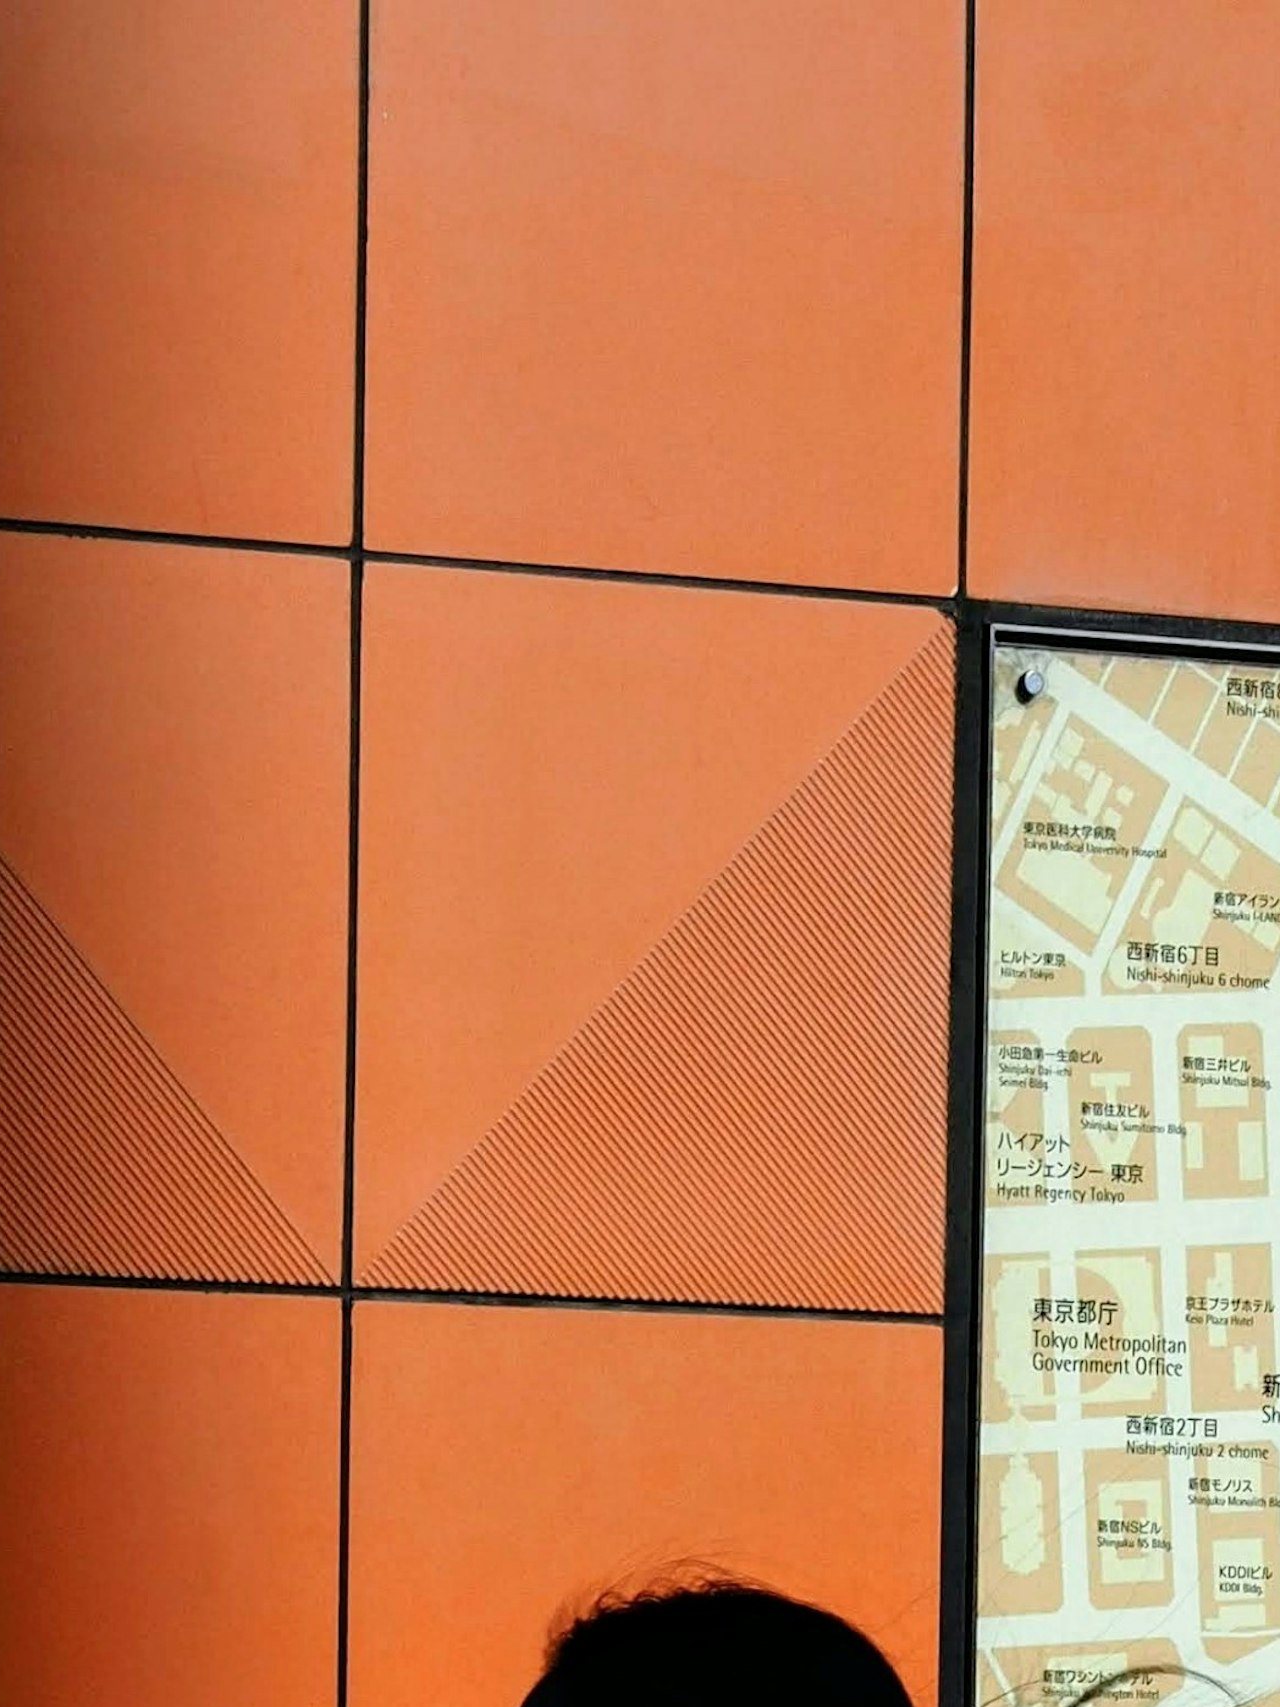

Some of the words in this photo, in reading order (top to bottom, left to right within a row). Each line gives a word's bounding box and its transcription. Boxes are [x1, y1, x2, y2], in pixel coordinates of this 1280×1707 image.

[1001, 951, 1067, 967] ヒルトン東京
[1127, 942, 1220, 967] 西新宿6丁目
[1126, 967, 1215, 989] Nishi-shinjuku
[1218, 973, 1226, 987] 6
[1229, 973, 1270, 990] chome
[1183, 1056, 1252, 1073] 新宿三井ビル
[997, 1132, 1070, 1153] ハイアット
[997, 1158, 1104, 1179] リージェンシー
[1111, 1163, 1144, 1184] 東京
[997, 1183, 1031, 1200] Hyatt
[1035, 1184, 1087, 1202] Regency
[1090, 1186, 1125, 1203] Tokyo
[1032, 1298, 1119, 1326] 東京都庁
[1032, 1329, 1078, 1352] Tokyo
[1083, 1332, 1187, 1355] Metropolitan
[1032, 1352, 1130, 1376] Government
[1135, 1356, 1183, 1377] Office
[1126, 1415, 1218, 1438] 西新宿2丁目
[1126, 1440, 1213, 1461] Nishi-shinjuku
[1216, 1444, 1224, 1458] 2
[1228, 1444, 1269, 1460] chome
[1219, 1566, 1273, 1581] KDDIビル
